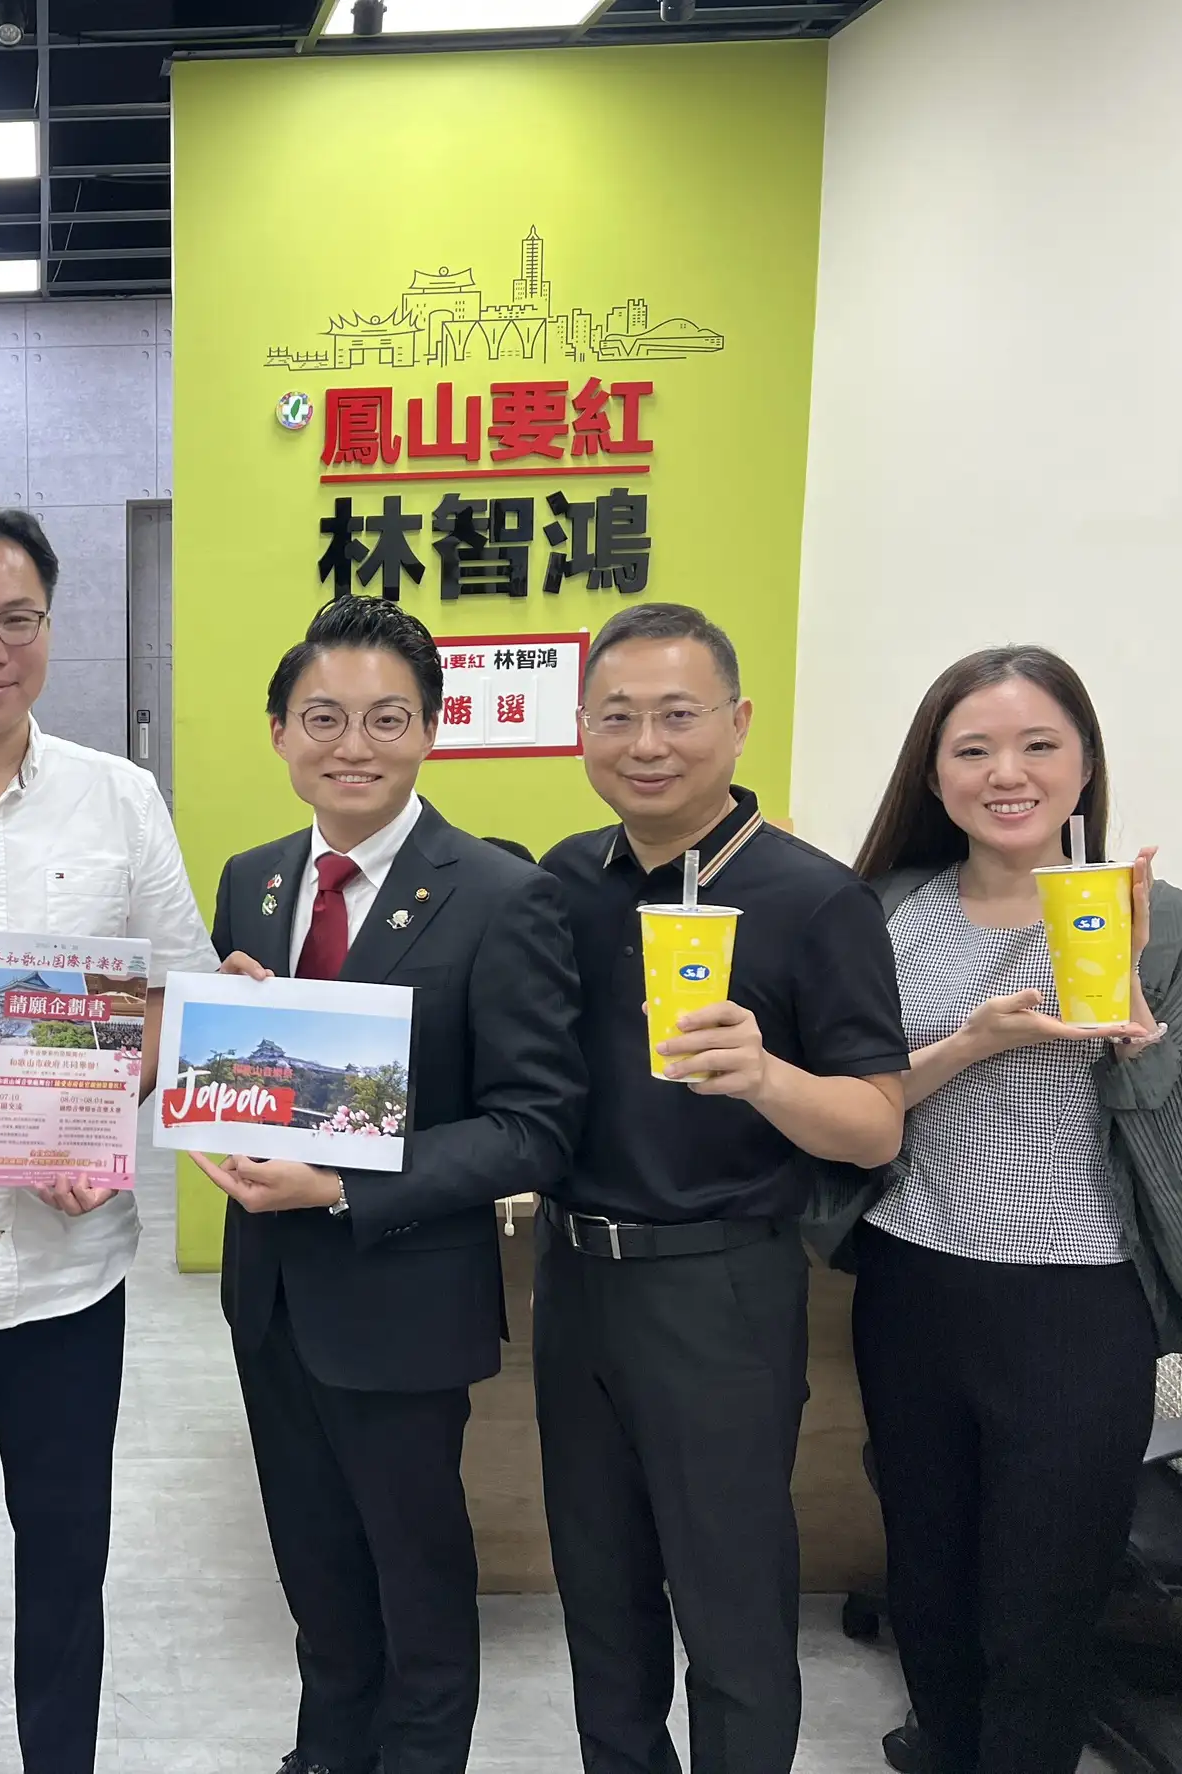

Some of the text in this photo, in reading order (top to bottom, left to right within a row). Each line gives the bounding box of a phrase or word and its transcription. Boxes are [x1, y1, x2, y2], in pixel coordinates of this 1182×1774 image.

[321, 377, 654, 466] 鳳山要紅
[318, 488, 651, 602] 林智鴻
[493, 647, 558, 670] 林智鴻
[8, 994, 106, 1019] 請願企劃書
[169, 1067, 277, 1122] Japan
